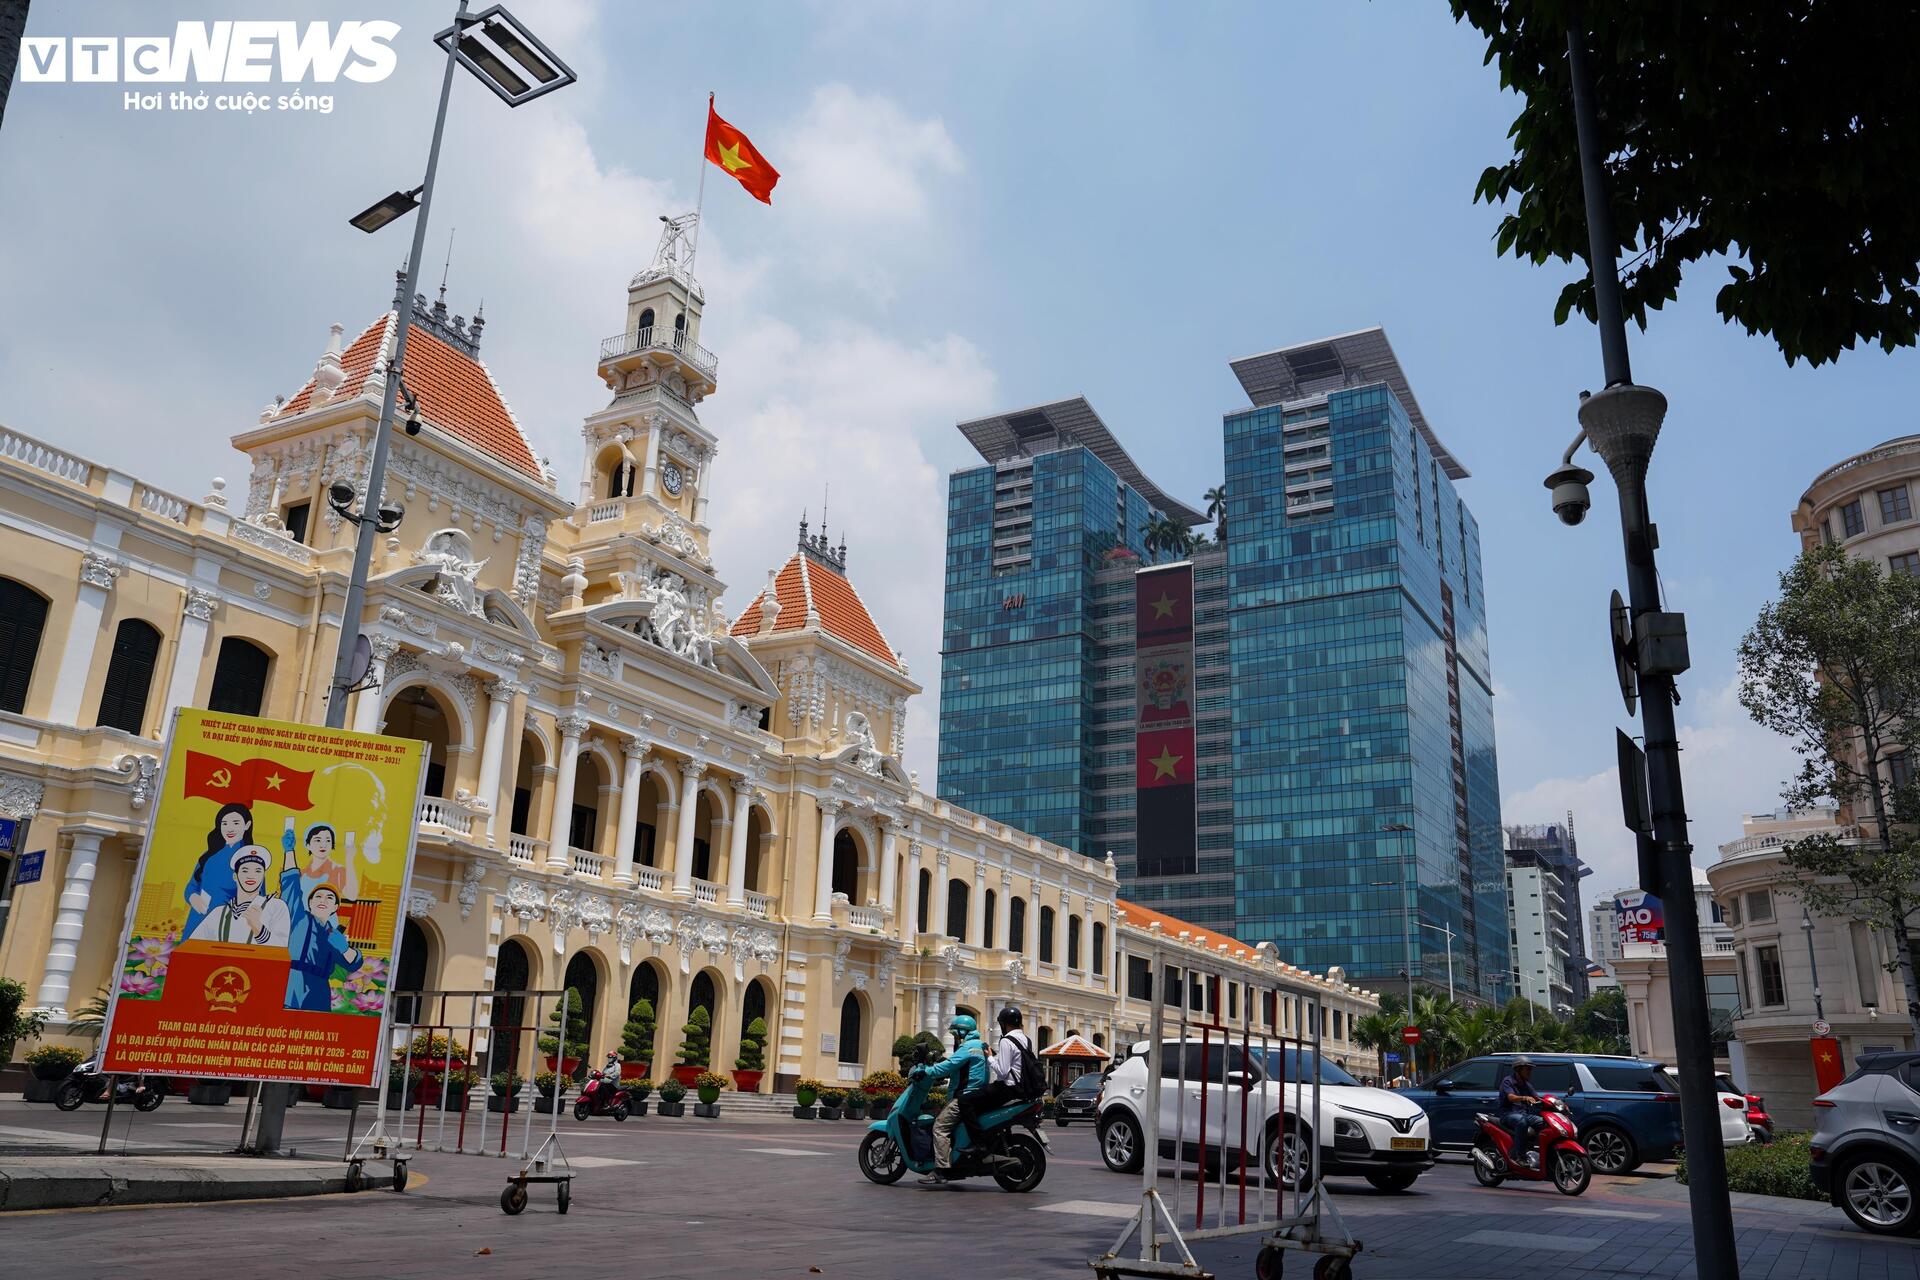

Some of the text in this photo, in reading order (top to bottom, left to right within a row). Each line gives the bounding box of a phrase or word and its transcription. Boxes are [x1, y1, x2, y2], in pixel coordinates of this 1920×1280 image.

[365, 754, 378, 762] 2026
[394, 746, 406, 754] XVI
[158, 1020, 181, 1032] THAM
[183, 1022, 196, 1032] GIA
[199, 1021, 216, 1034] BẦU
[217, 1022, 230, 1034] CỬ
[230, 1025, 244, 1038] ĐẠI
[246, 1024, 264, 1036] BIỂU
[266, 1026, 288, 1038] QUỐC
[289, 1028, 302, 1040] HỘI
[326, 1032, 338, 1042] XVI
[116, 1032, 126, 1044] VÀ
[129, 1034, 143, 1048] ĐẠI
[145, 1032, 166, 1046] BIỂU
[166, 1037, 181, 1050] HỘI
[182, 1036, 206, 1048] ĐỒNG
[208, 1039, 230, 1050] NHÂN
[232, 1041, 249, 1052] DÂN
[251, 1040, 268, 1052] CÁC
[270, 1042, 286, 1054] CẤP
[287, 1044, 312, 1057] NHIỆM
[314, 1045, 324, 1056] KỲ
[326, 1048, 345, 1057] 2026
[352, 1050, 370, 1059] 2031
[116, 1049, 365, 1074] LÀ QUYỀN LỢI, TRÁCH NHIỆM THIÊNG LIÊNG CỦA MỖI CÔNG DÂN!
